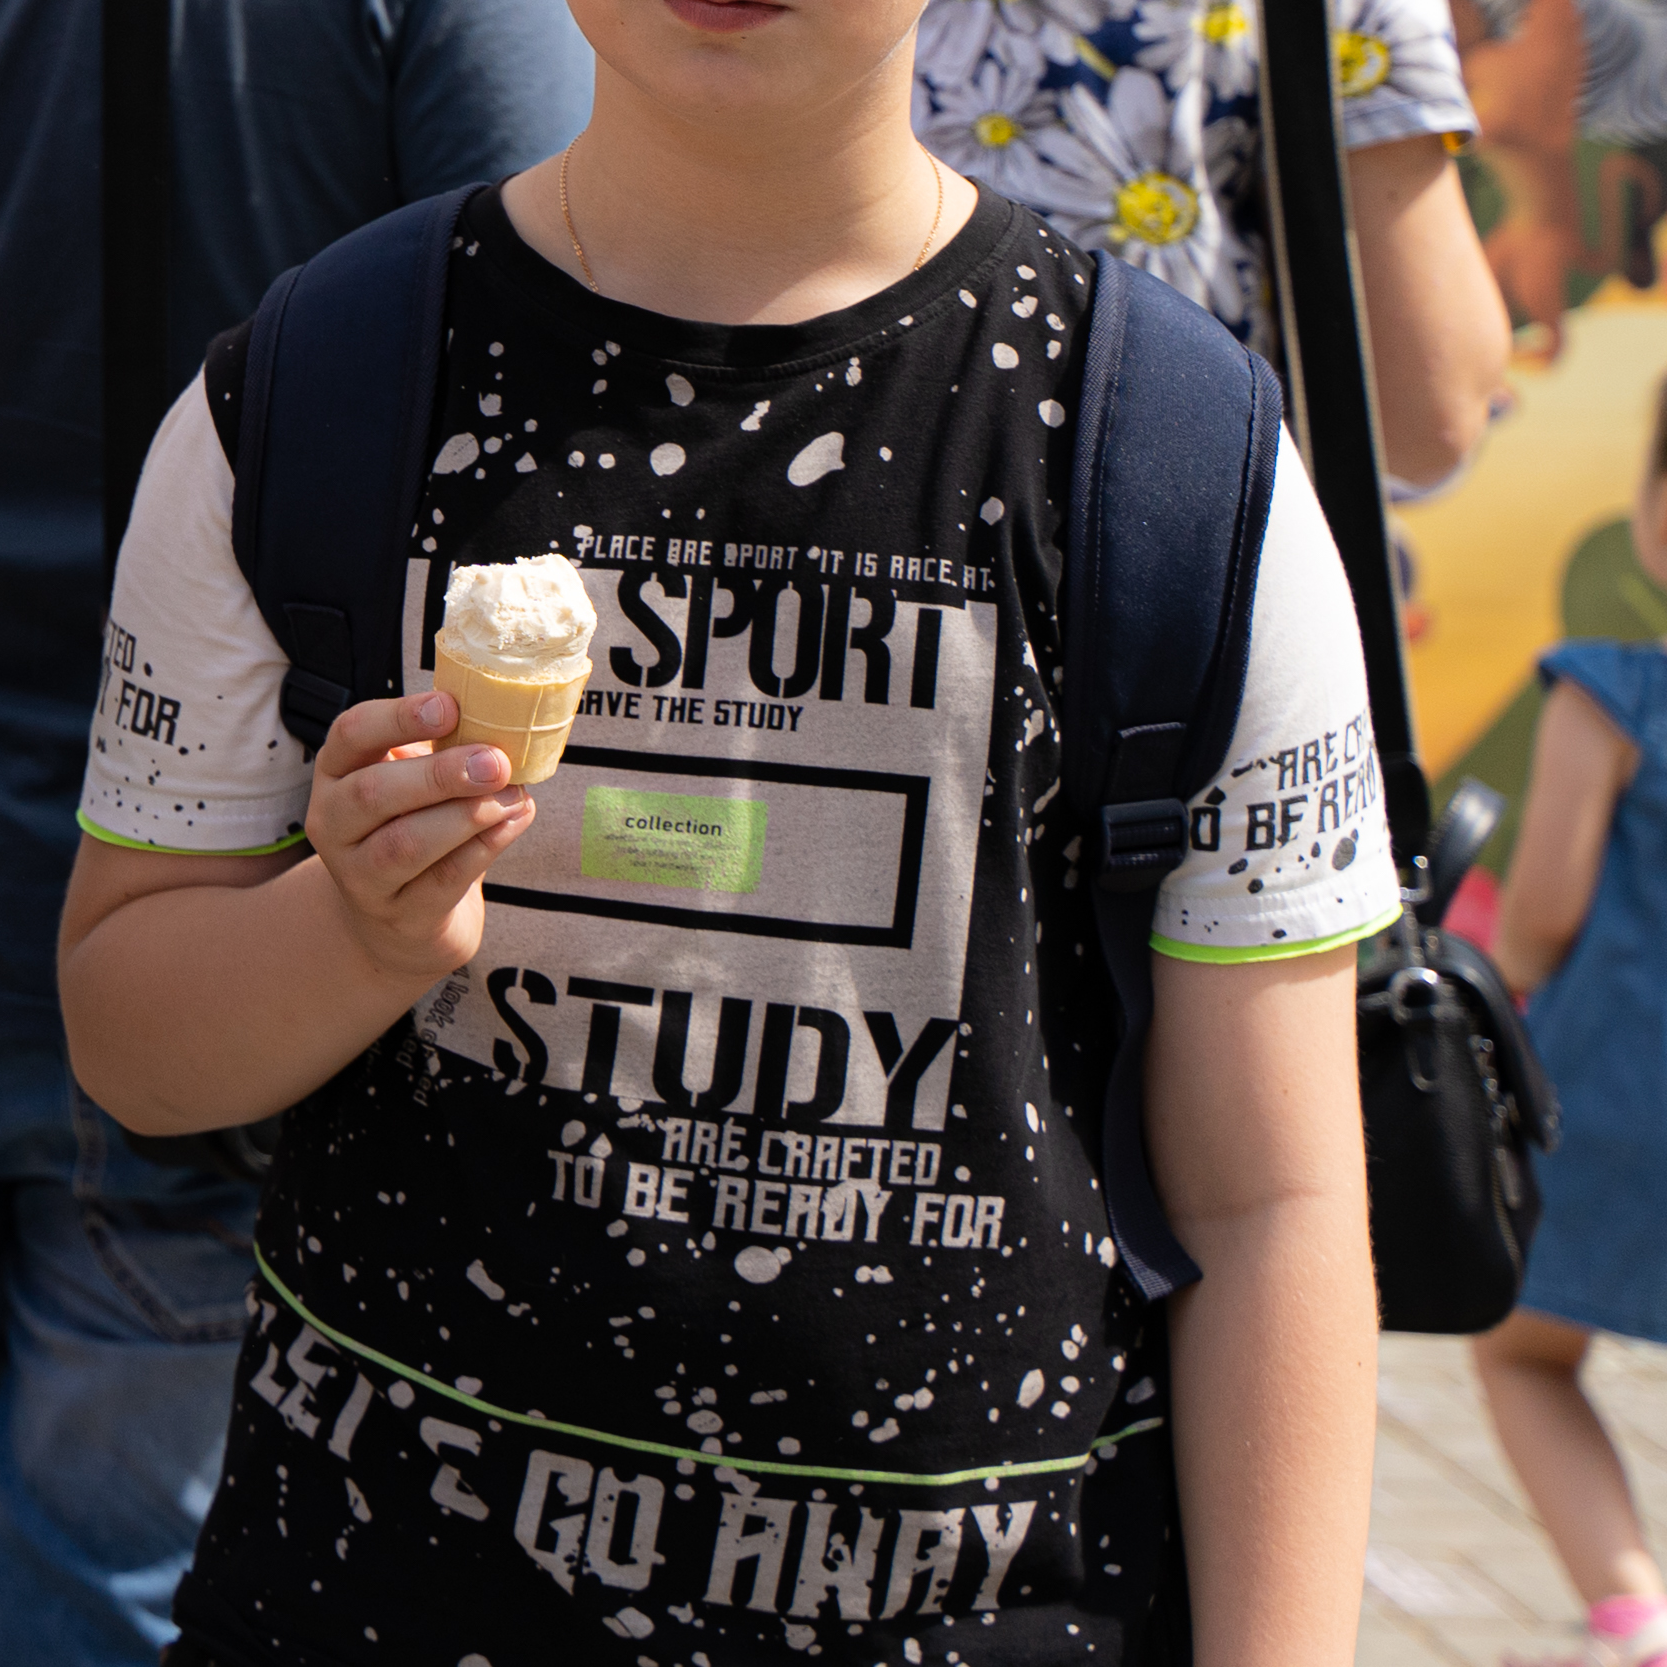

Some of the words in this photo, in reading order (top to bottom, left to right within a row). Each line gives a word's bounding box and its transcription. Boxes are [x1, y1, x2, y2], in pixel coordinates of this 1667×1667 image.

[578, 534, 656, 562] PLACE
[854, 551, 879, 578] IS
[609, 570, 943, 711] SPORT
[652, 695, 703, 725] THE
[713, 698, 804, 733] STUDY
[624, 814, 723, 837] collection
[485, 966, 963, 1130] STUDY
[662, 1114, 750, 1176] ARE
[757, 1131, 943, 1188] CRAFTED
[546, 1148, 606, 1208] TO
[623, 1161, 690, 1224] BE
[713, 1174, 894, 1247] READY
[912, 1191, 1006, 1251] FOR
[513, 1447, 666, 1598] GO
[702, 1490, 1038, 1622] AWAY
